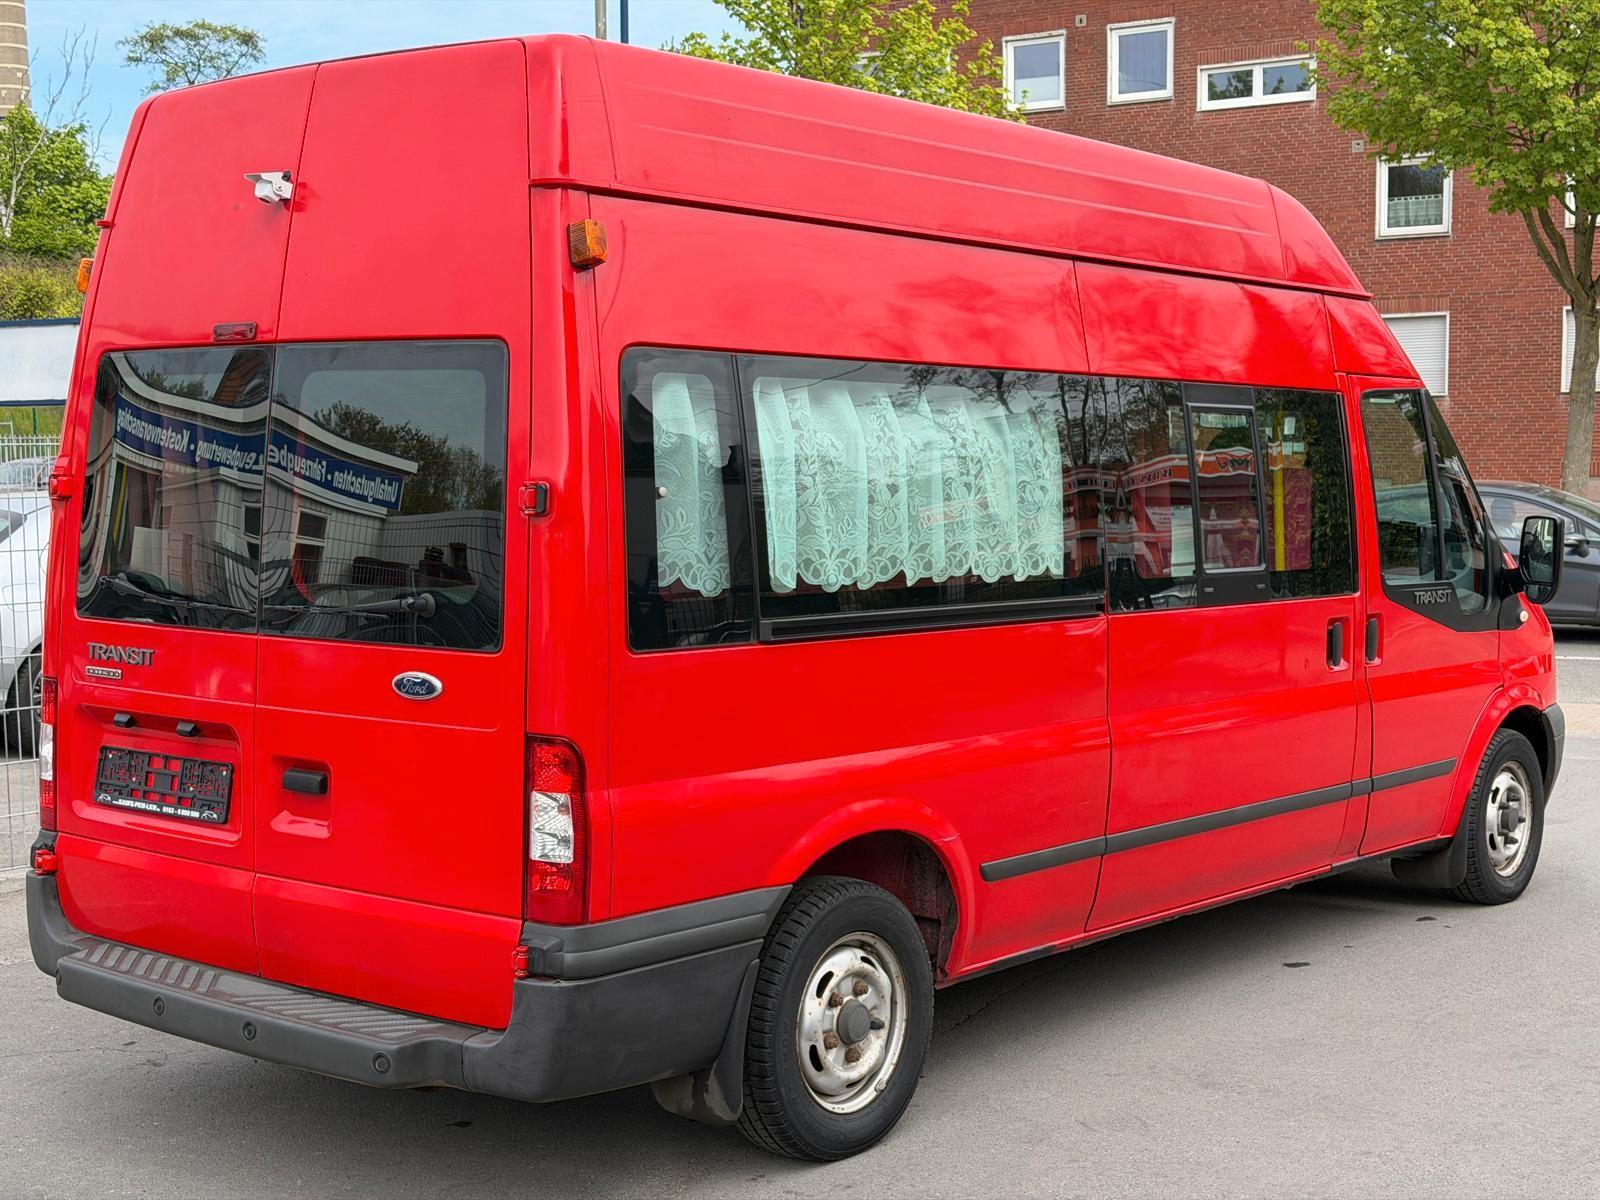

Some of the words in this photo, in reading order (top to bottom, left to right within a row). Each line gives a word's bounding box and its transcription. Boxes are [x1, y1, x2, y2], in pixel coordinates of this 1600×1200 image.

[1414, 589, 1452, 605] TRANSIT
[87, 642, 154, 667] TRANSIT
[400, 677, 429, 695] Ford
